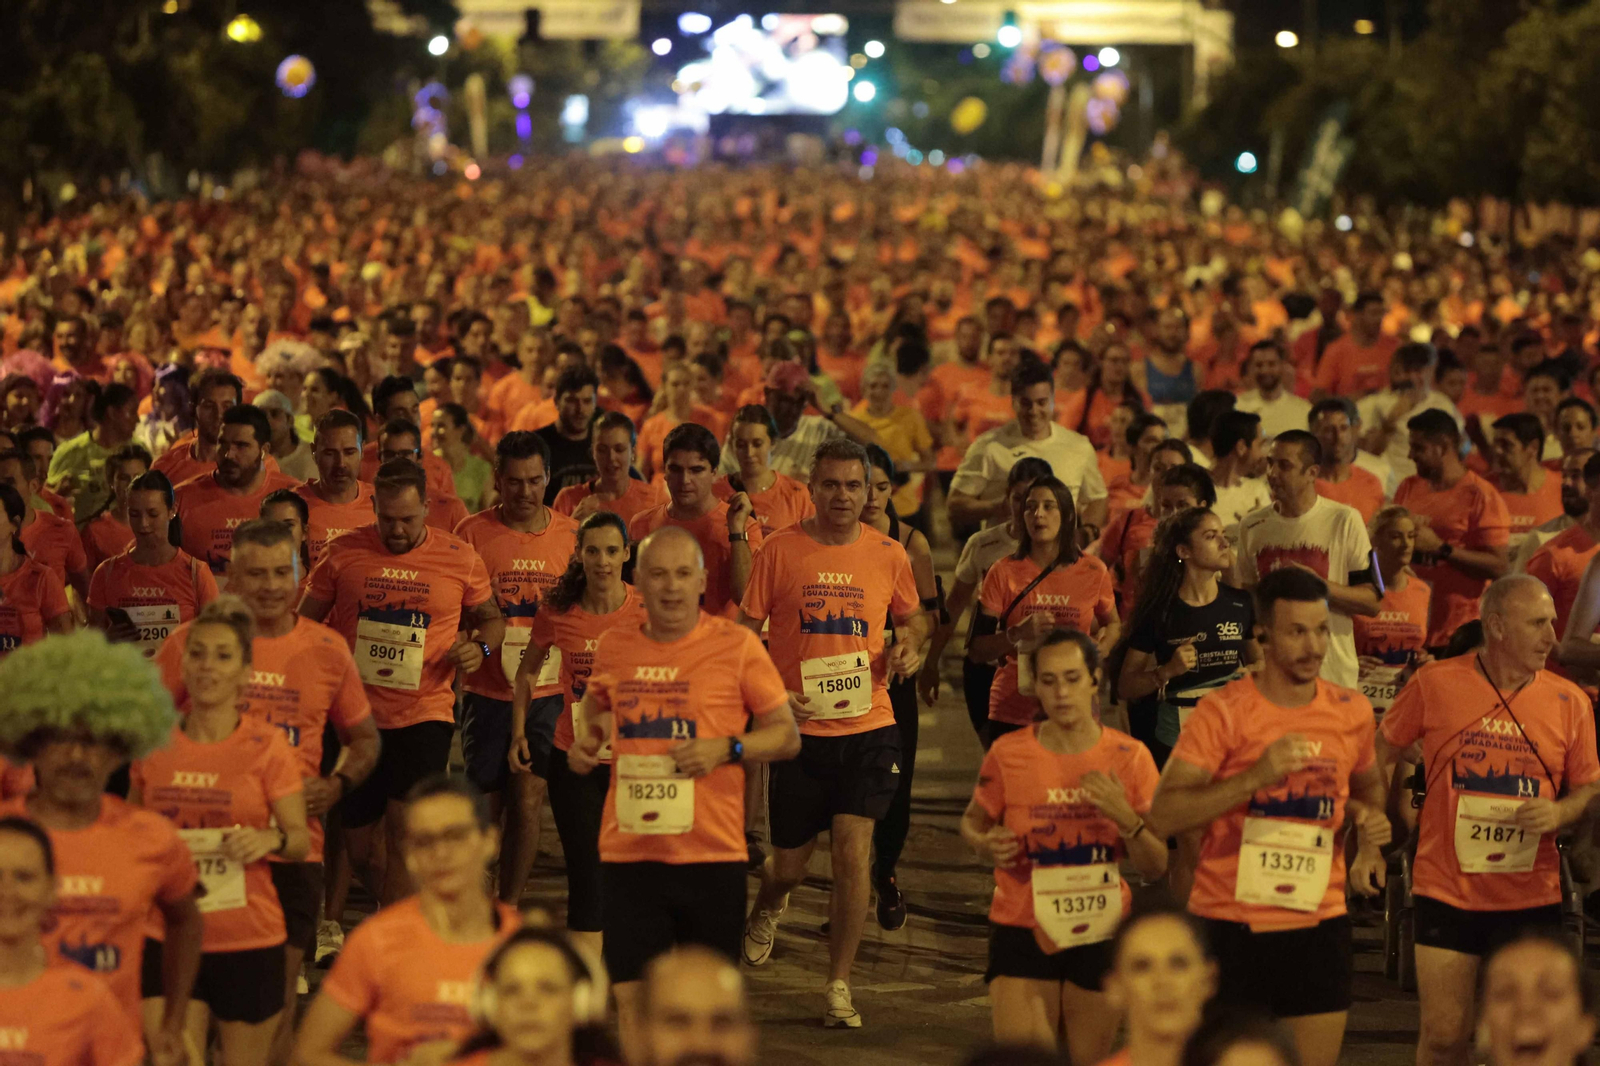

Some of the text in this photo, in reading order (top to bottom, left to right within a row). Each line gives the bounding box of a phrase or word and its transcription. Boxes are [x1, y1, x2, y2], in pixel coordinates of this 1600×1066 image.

[512, 559, 546, 571] XXXV
[382, 567, 419, 580] XXXV
[818, 572, 853, 585] XXXV
[369, 582, 430, 594] GUADALQUIVIR
[397, 580, 430, 588] NOCTURNA
[132, 587, 166, 597] XXXV
[806, 591, 864, 599] GUADALQUIVIR
[1036, 594, 1070, 606] XXXV
[1380, 611, 1410, 622] XXXV
[1216, 621, 1239, 635] 365
[369, 644, 405, 662] 8901
[634, 666, 679, 682] XXXV
[817, 675, 861, 694] 15800
[1482, 717, 1526, 737] XXXV
[628, 783, 678, 800] 18230
[1470, 824, 1525, 844] 21871
[1259, 851, 1316, 875] 13378
[1051, 894, 1107, 914] 13379
